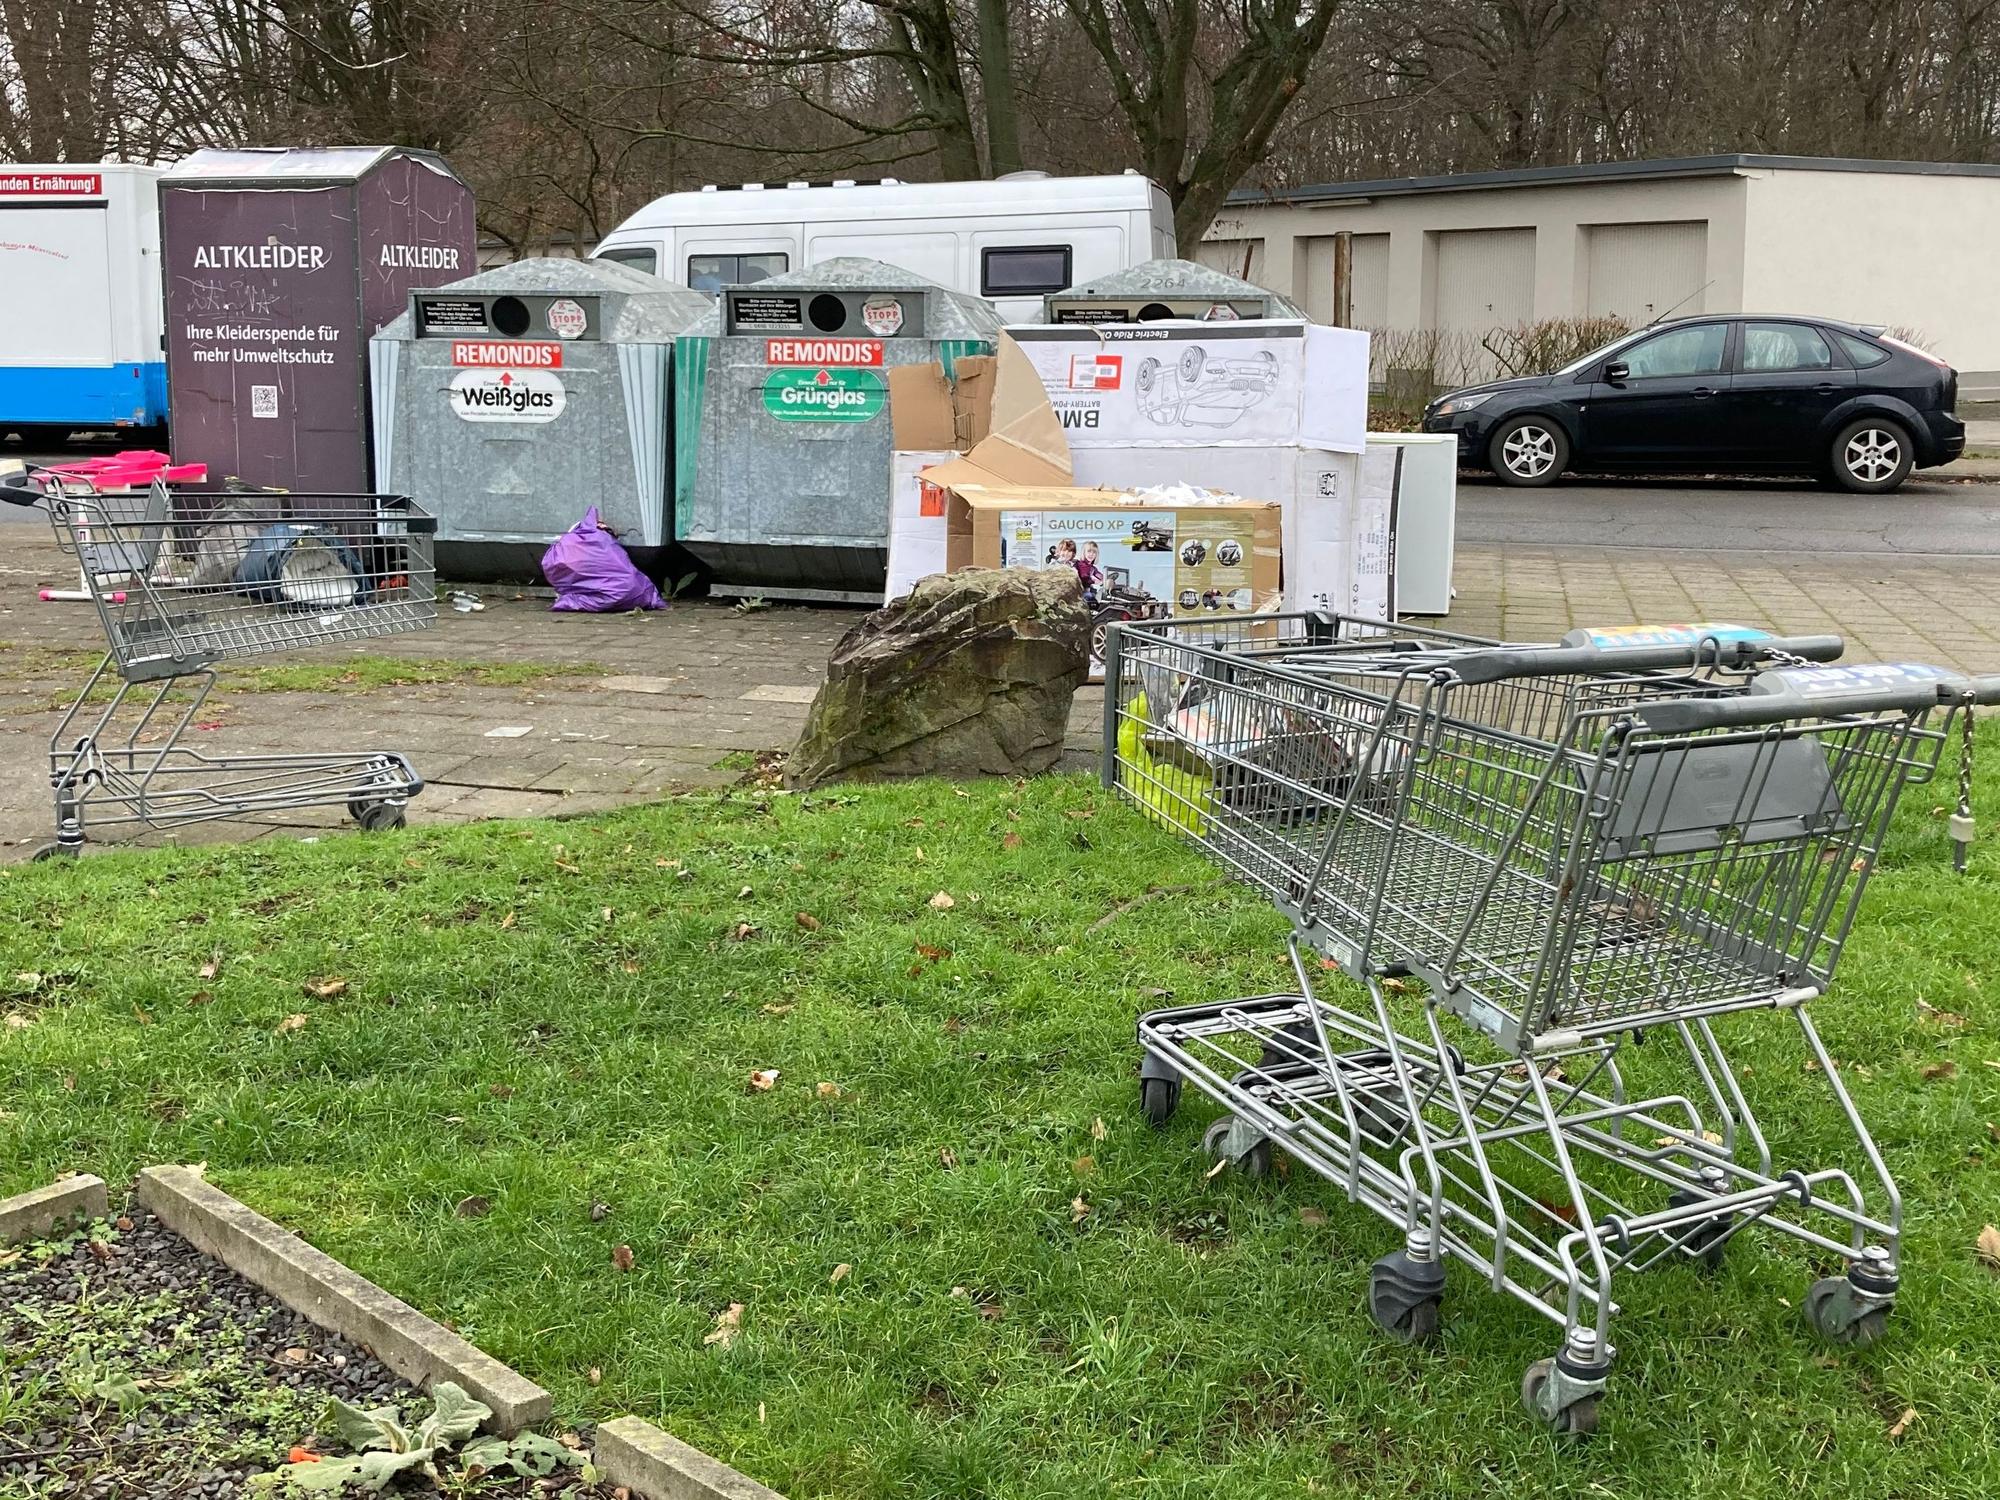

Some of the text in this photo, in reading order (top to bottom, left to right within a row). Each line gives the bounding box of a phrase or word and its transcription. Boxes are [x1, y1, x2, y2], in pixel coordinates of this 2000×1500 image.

[0, 176, 96, 193] nden Ernährung!
[193, 245, 325, 269] ALTKLEIDER
[380, 244, 460, 270] ALTKLEIDER
[1140, 278, 1185, 289] 2264
[553, 315, 582, 323] STOPP
[867, 311, 898, 319] STOPP
[186, 324, 340, 344] Ihre Kleiderspende für
[1113, 330, 1134, 339] Ride
[1134, 330, 1169, 339] Electric
[193, 348, 334, 364] mehr Umweltschutz
[462, 386, 553, 412] Weißglas
[781, 386, 866, 409] Grünglas
[1054, 410, 1100, 429] BM
[1048, 519, 1125, 530] GAUCHO XP
